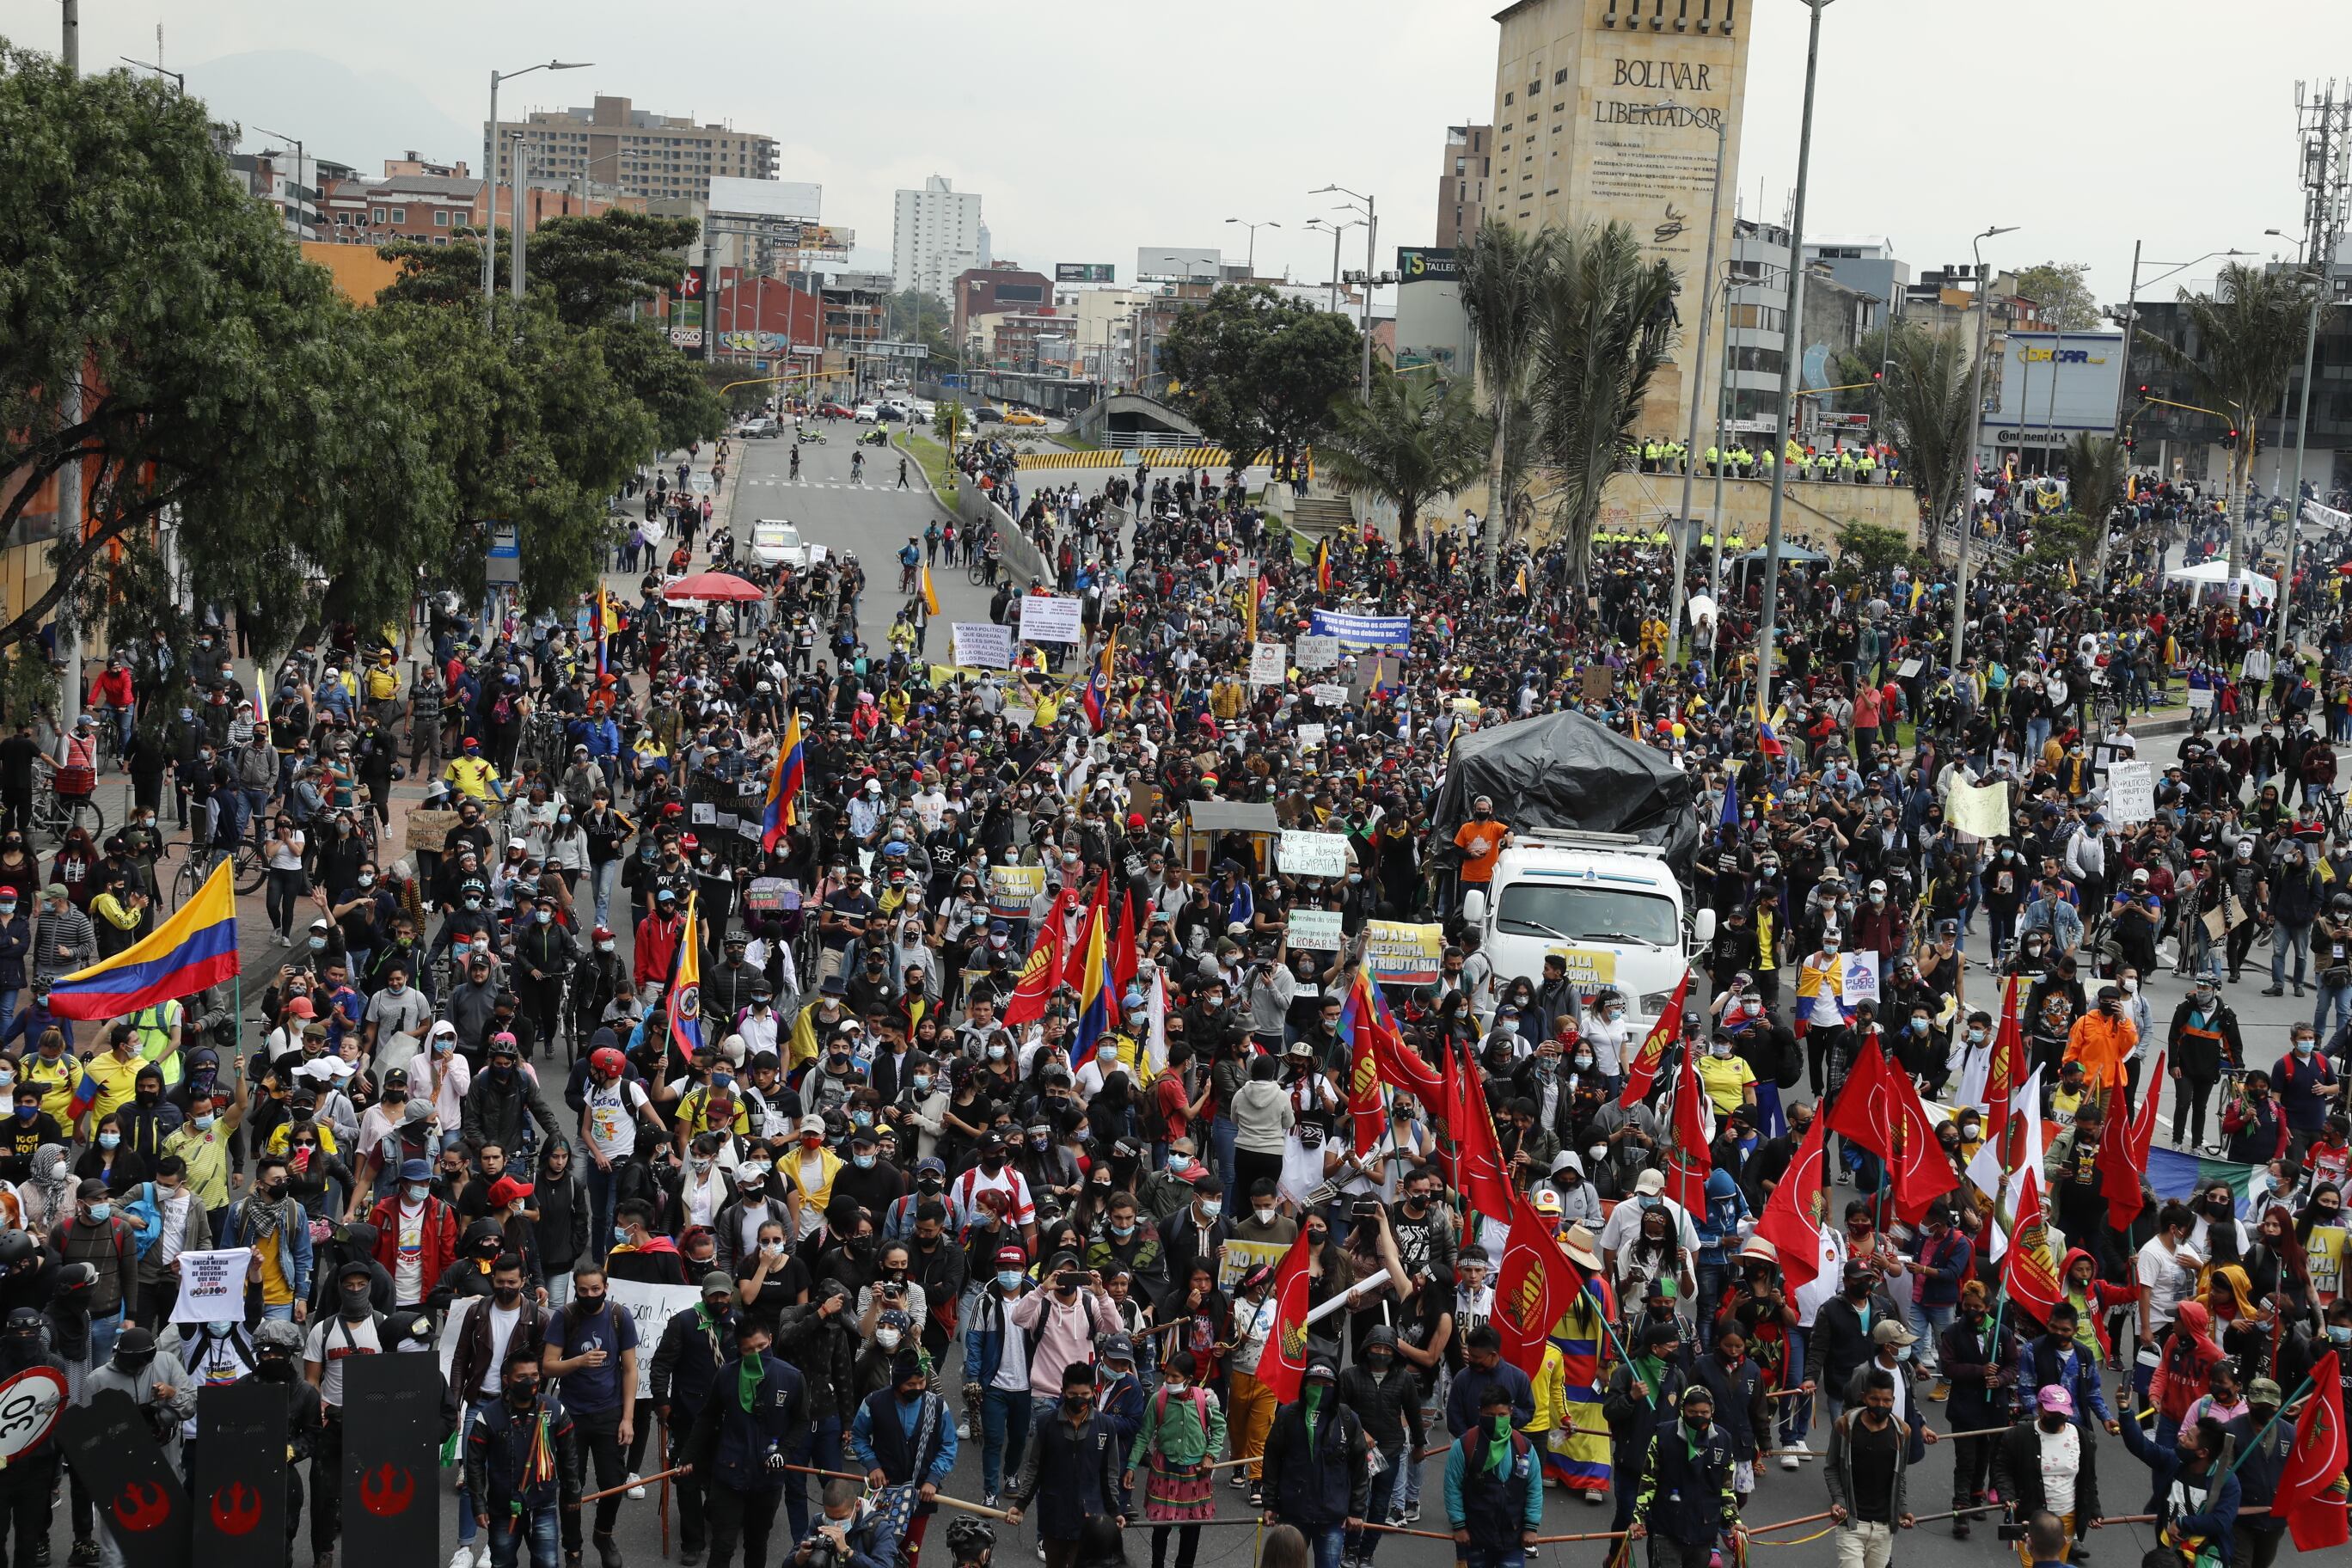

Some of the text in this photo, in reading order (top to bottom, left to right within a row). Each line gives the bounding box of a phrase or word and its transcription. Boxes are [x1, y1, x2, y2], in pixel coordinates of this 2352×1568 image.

[1614, 59, 1712, 91] BOLIVAR
[1596, 101, 1721, 129] LIBERTADOR
[1998, 430, 2058, 443] Contnentl
[2122, 797, 2135, 805] NO
[1283, 857, 1295, 870] LA
[992, 872, 1031, 885] NO A LA
[1372, 928, 1418, 944] NO A LA
[1371, 942, 1426, 959] REFORMA
[1370, 956, 1438, 973] TRIBUTARIA
[1567, 954, 1594, 970] A LA
[1845, 977, 1875, 987] PURO
[1227, 1251, 1251, 1268] NO
[633, 1302, 652, 1321] son
[0, 1394, 36, 1439] 30
